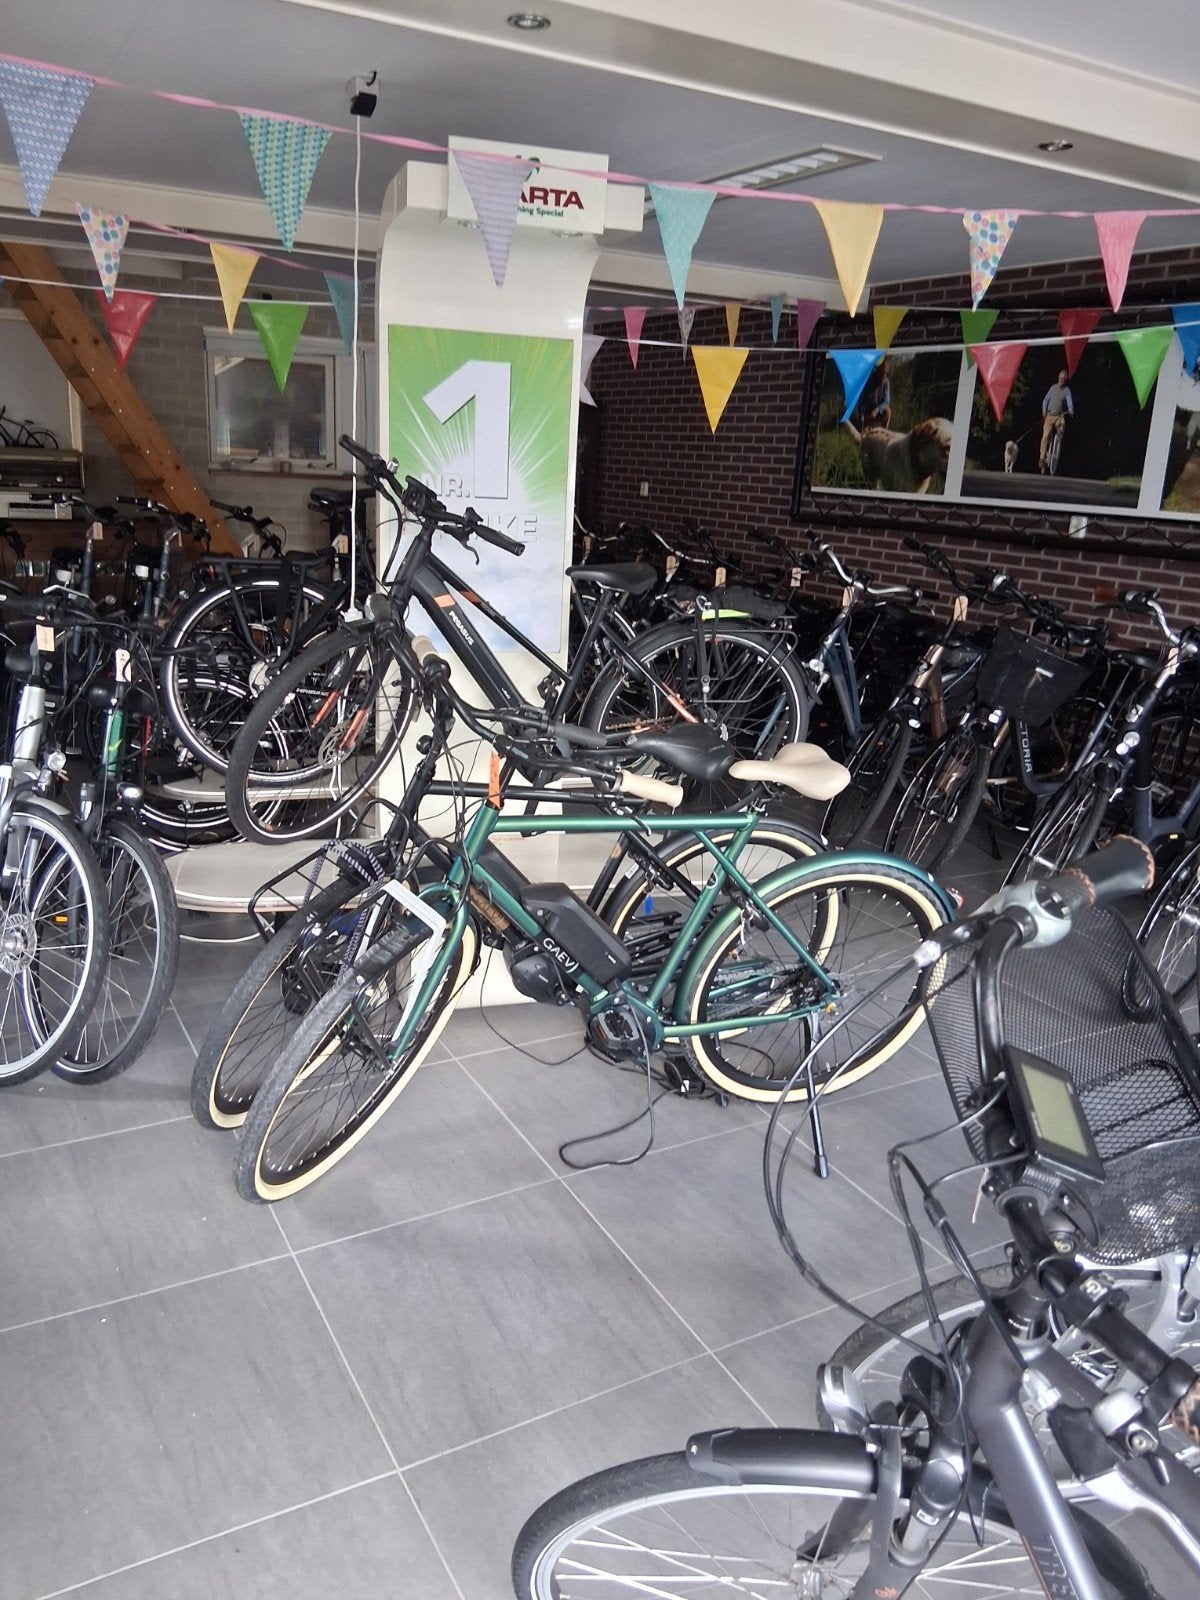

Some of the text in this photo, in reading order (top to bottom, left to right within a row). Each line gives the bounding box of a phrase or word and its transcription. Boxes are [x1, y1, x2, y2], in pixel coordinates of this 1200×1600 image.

[536, 206, 564, 218] Special
[422, 359, 511, 500] 1
[448, 610, 475, 646] PEGASUS
